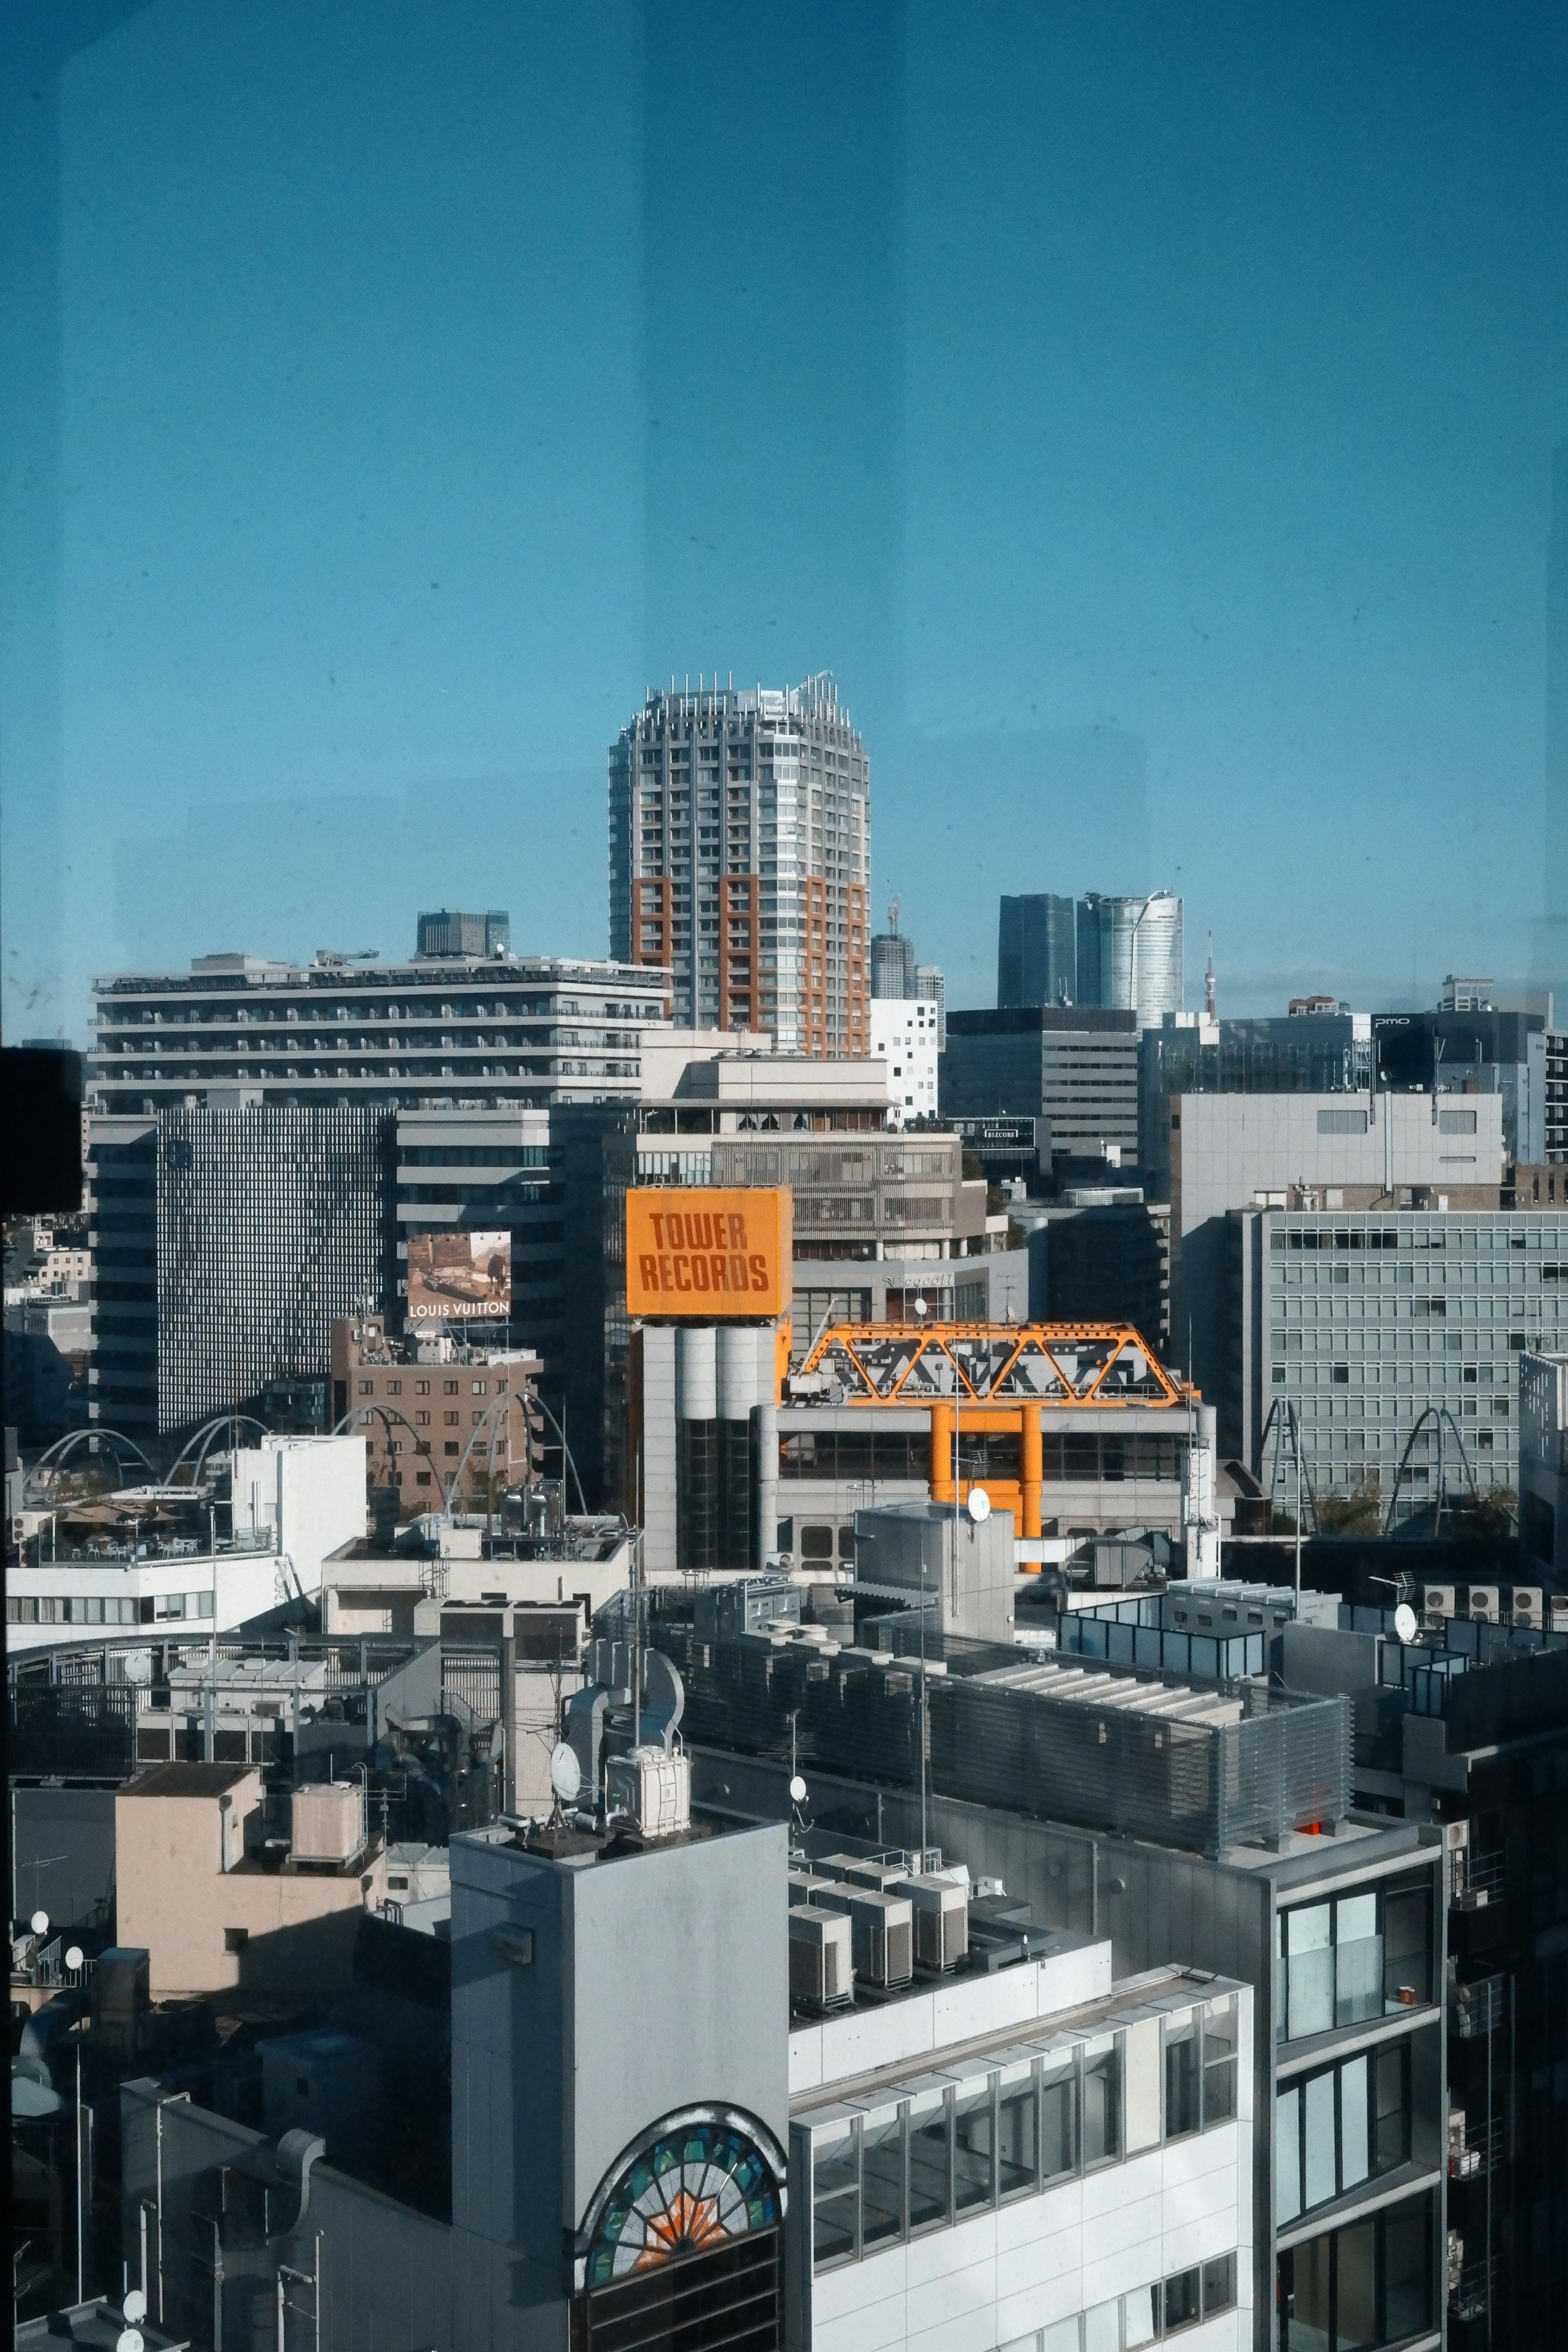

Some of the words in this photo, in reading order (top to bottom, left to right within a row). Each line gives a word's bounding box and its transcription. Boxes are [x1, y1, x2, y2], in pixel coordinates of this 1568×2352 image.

[1375, 1018, 1410, 1028] pmo
[649, 1213, 748, 1250] TOWER
[639, 1254, 769, 1292] RECORDS
[410, 1305, 449, 1317] LOUIS
[453, 1301, 509, 1315] VUITTON
